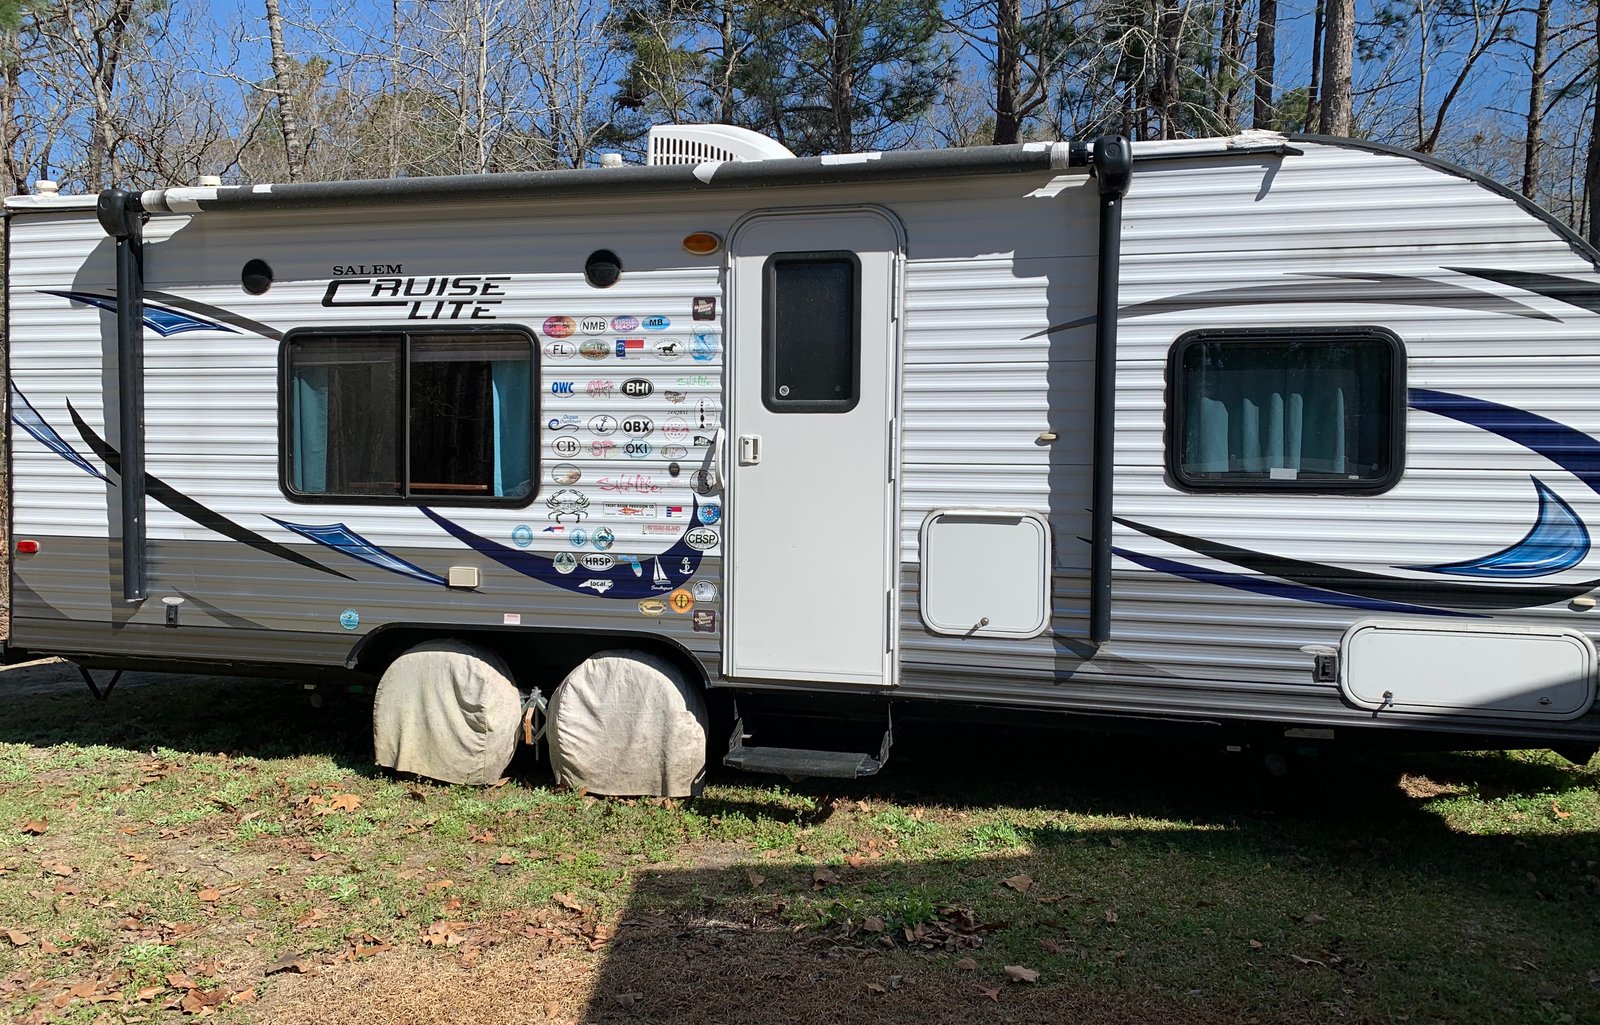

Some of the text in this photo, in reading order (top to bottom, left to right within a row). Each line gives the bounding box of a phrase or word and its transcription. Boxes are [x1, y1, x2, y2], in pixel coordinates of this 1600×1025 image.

[333, 264, 403, 275] SALEM
[321, 277, 511, 307] CRUISE
[408, 301, 502, 319] LITE
[583, 321, 606, 331] NMB
[649, 318, 664, 326] MB
[553, 344, 568, 354] FL
[551, 381, 574, 394] OWC
[626, 382, 649, 394] BHI
[623, 420, 650, 432] OBX
[556, 440, 576, 452] CB
[625, 443, 648, 454] OKI
[688, 534, 716, 544] CBSP
[585, 557, 611, 566] HRSP
